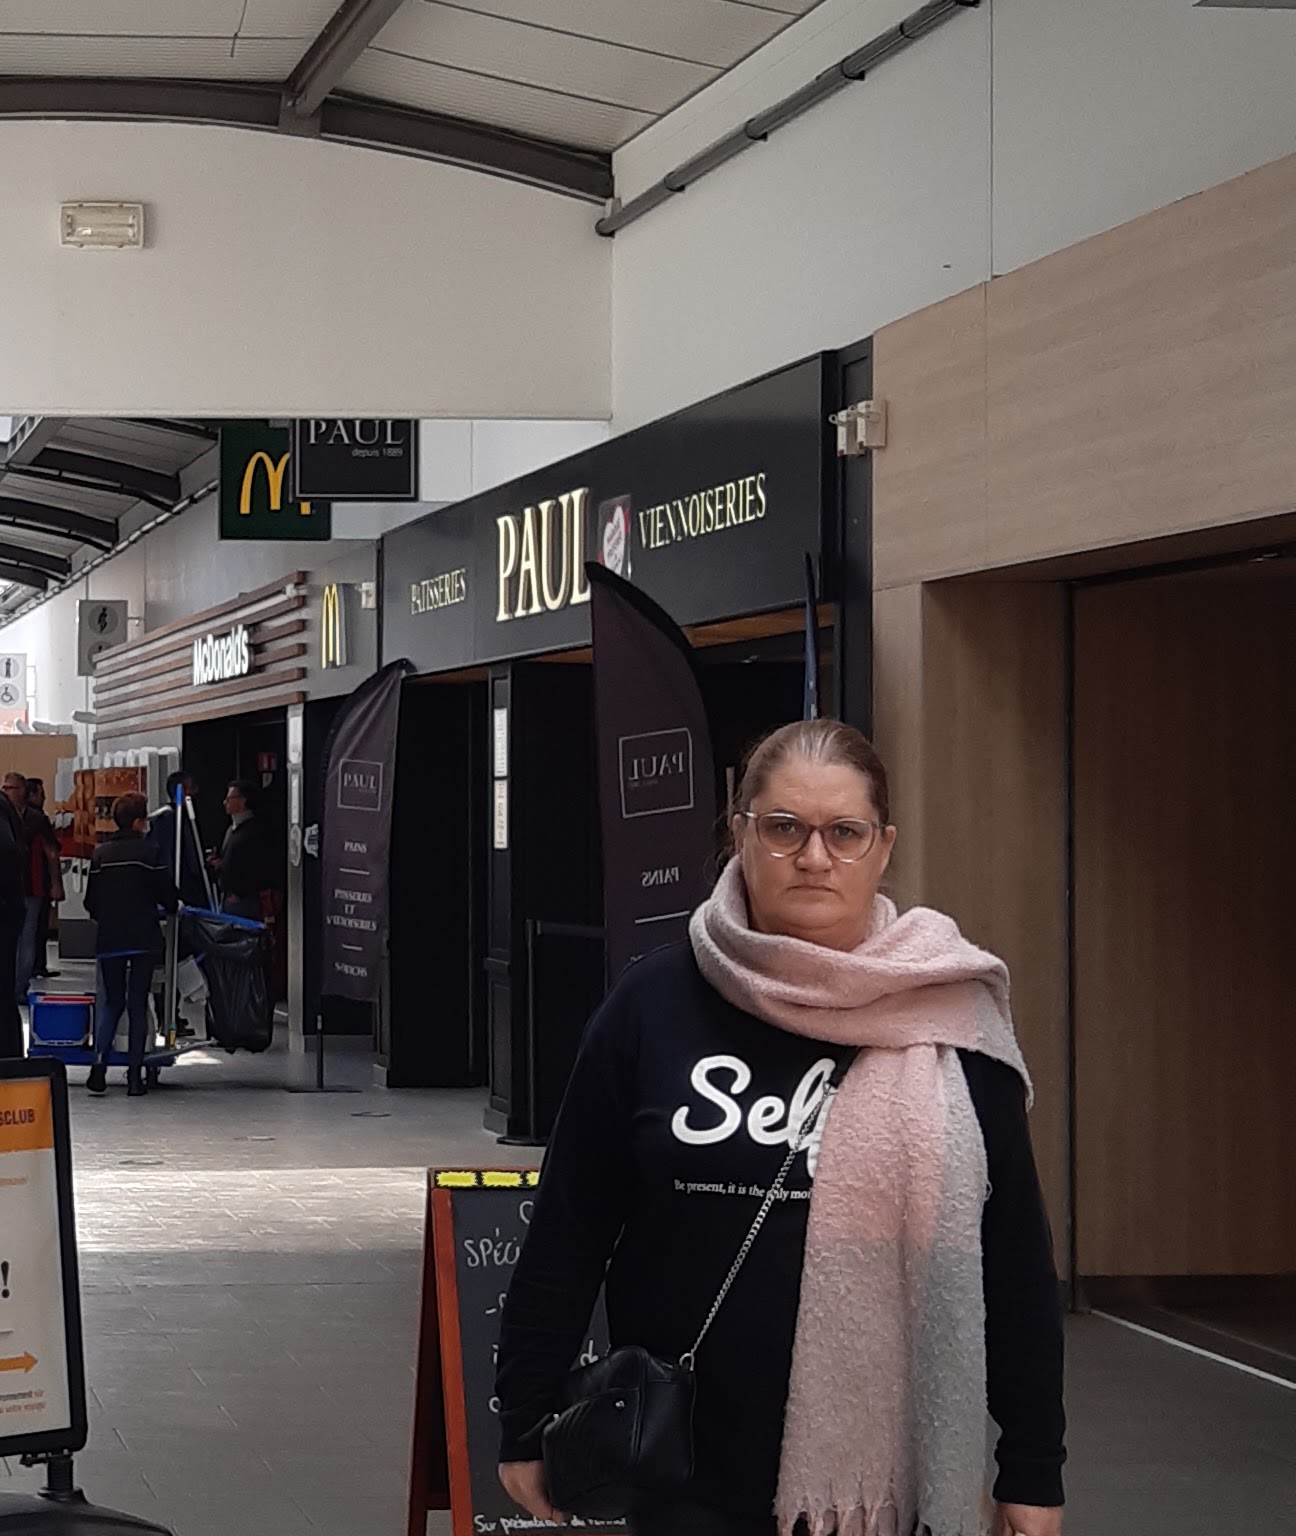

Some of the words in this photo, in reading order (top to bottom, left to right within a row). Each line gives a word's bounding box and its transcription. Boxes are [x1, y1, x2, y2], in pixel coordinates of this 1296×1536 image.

[309, 419, 404, 445] PAUL
[638, 472, 767, 550] VIENNOISERIES
[496, 487, 591, 623] PAUL
[193, 623, 250, 687] McDonald's
[343, 772, 377, 789] PAUL
[687, 1182, 726, 1195] present,
[727, 1181, 736, 1194] it
[738, 1182, 747, 1195] is
[749, 1184, 766, 1198] the
[473, 1514, 496, 1533] Sur
